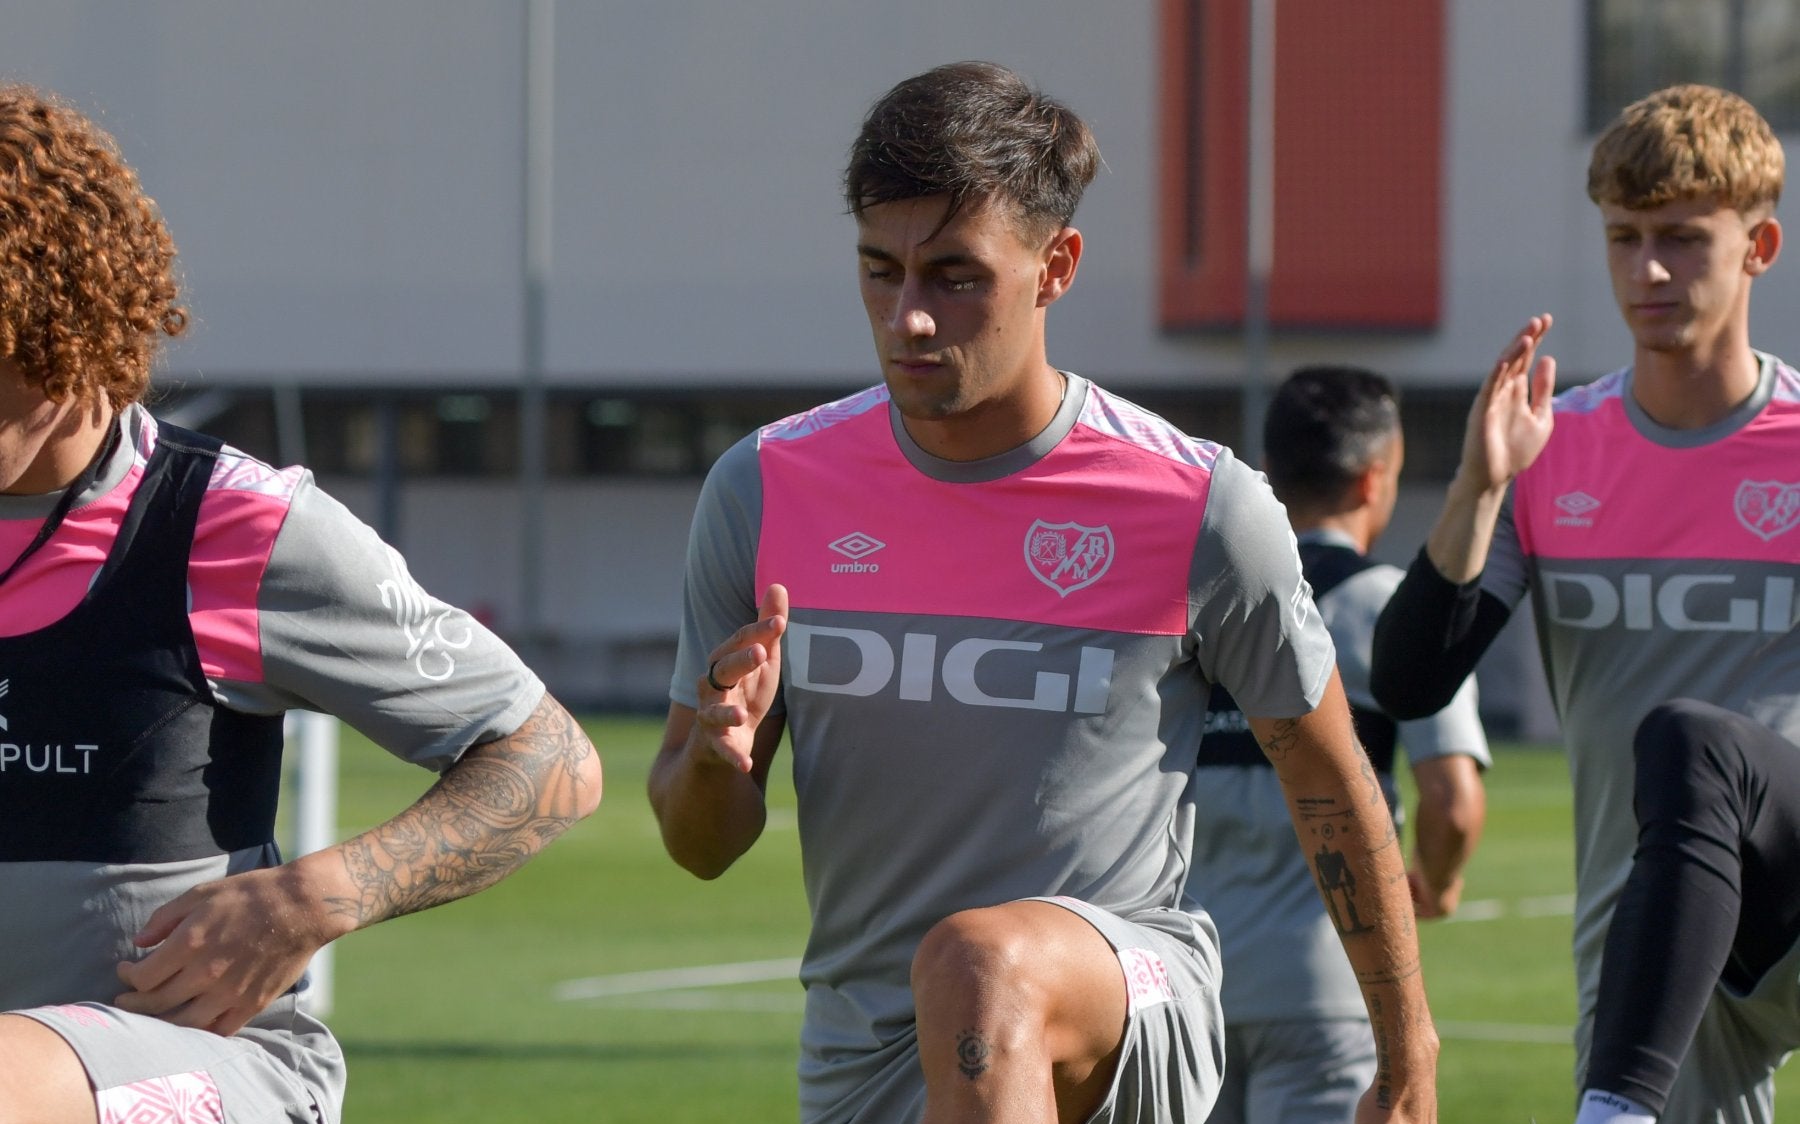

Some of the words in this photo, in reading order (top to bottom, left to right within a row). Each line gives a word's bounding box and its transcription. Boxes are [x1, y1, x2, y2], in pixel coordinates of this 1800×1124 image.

[831, 561, 879, 573] umbro
[1541, 571, 1794, 632] DIGI
[787, 621, 1115, 714] DIGI
[0, 743, 99, 774] PULT
